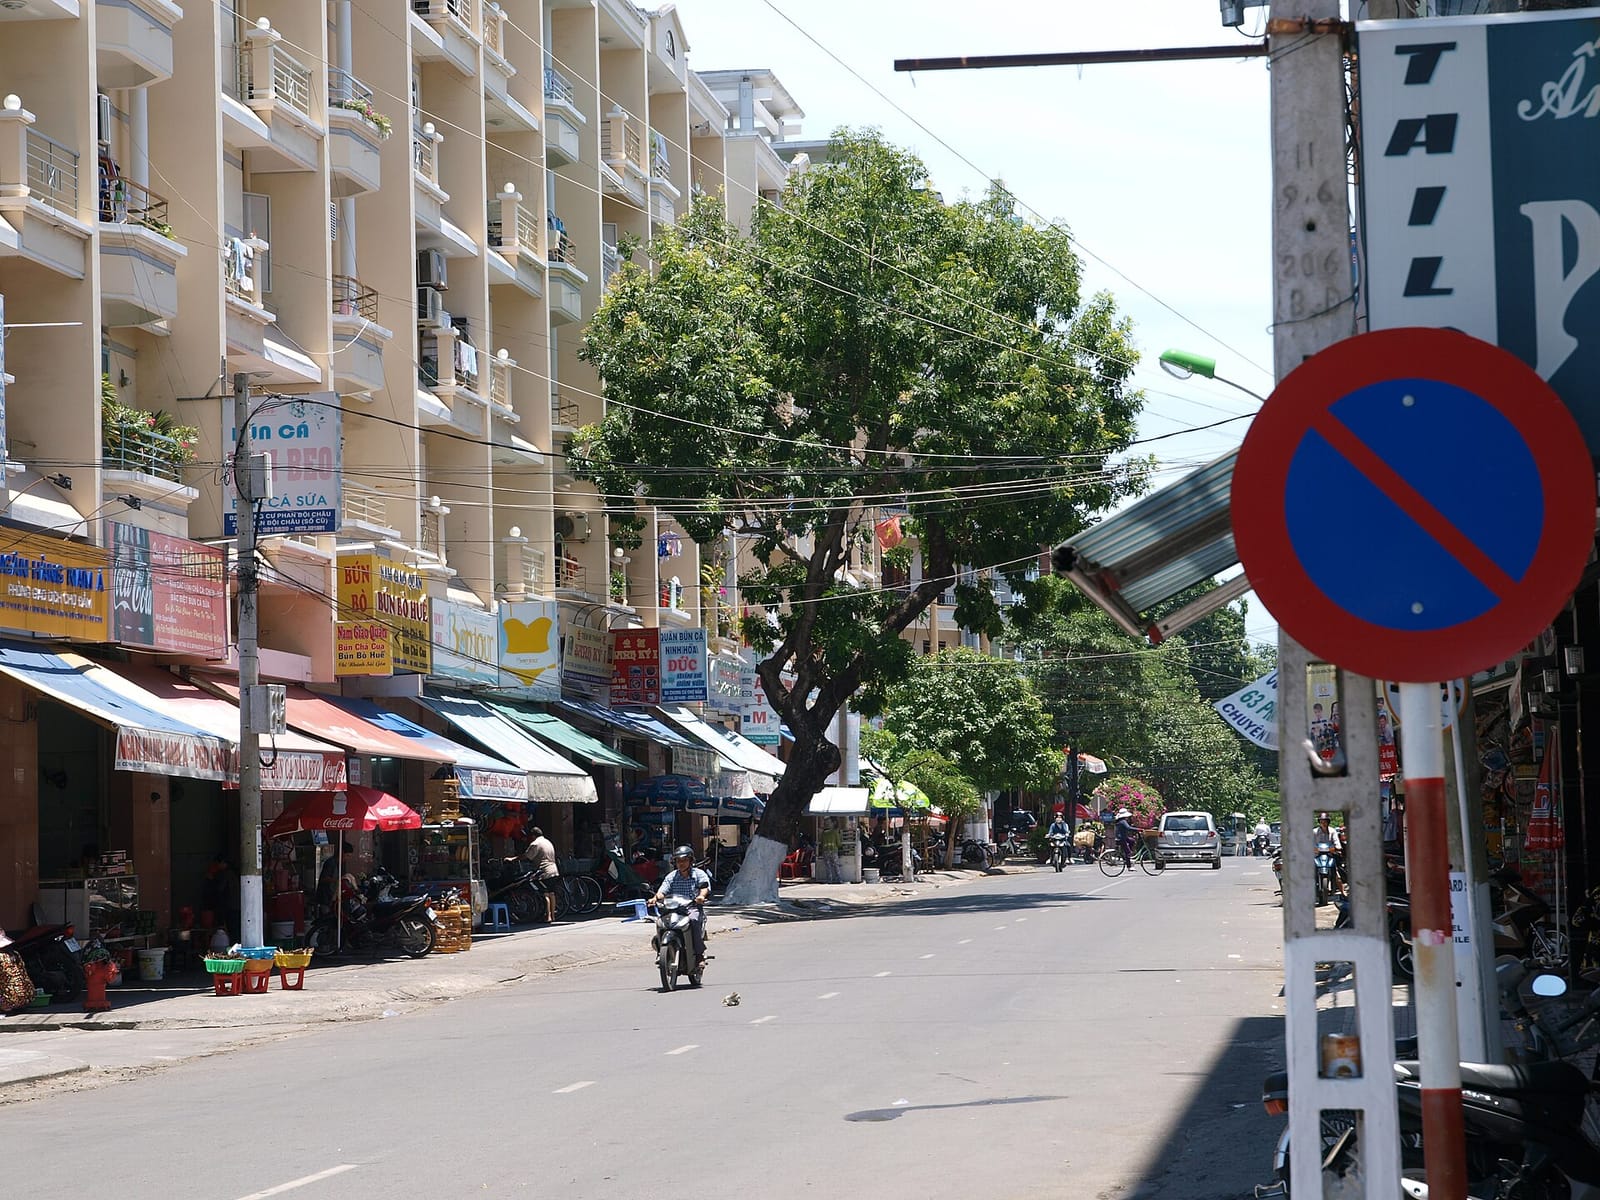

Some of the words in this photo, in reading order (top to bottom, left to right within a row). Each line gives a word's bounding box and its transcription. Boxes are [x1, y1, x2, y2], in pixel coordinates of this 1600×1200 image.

[1384, 41, 1467, 334] TAIL
[344, 561, 370, 585] BÚN
[351, 588, 367, 612] BÒ
[1240, 690, 1265, 709] 63
